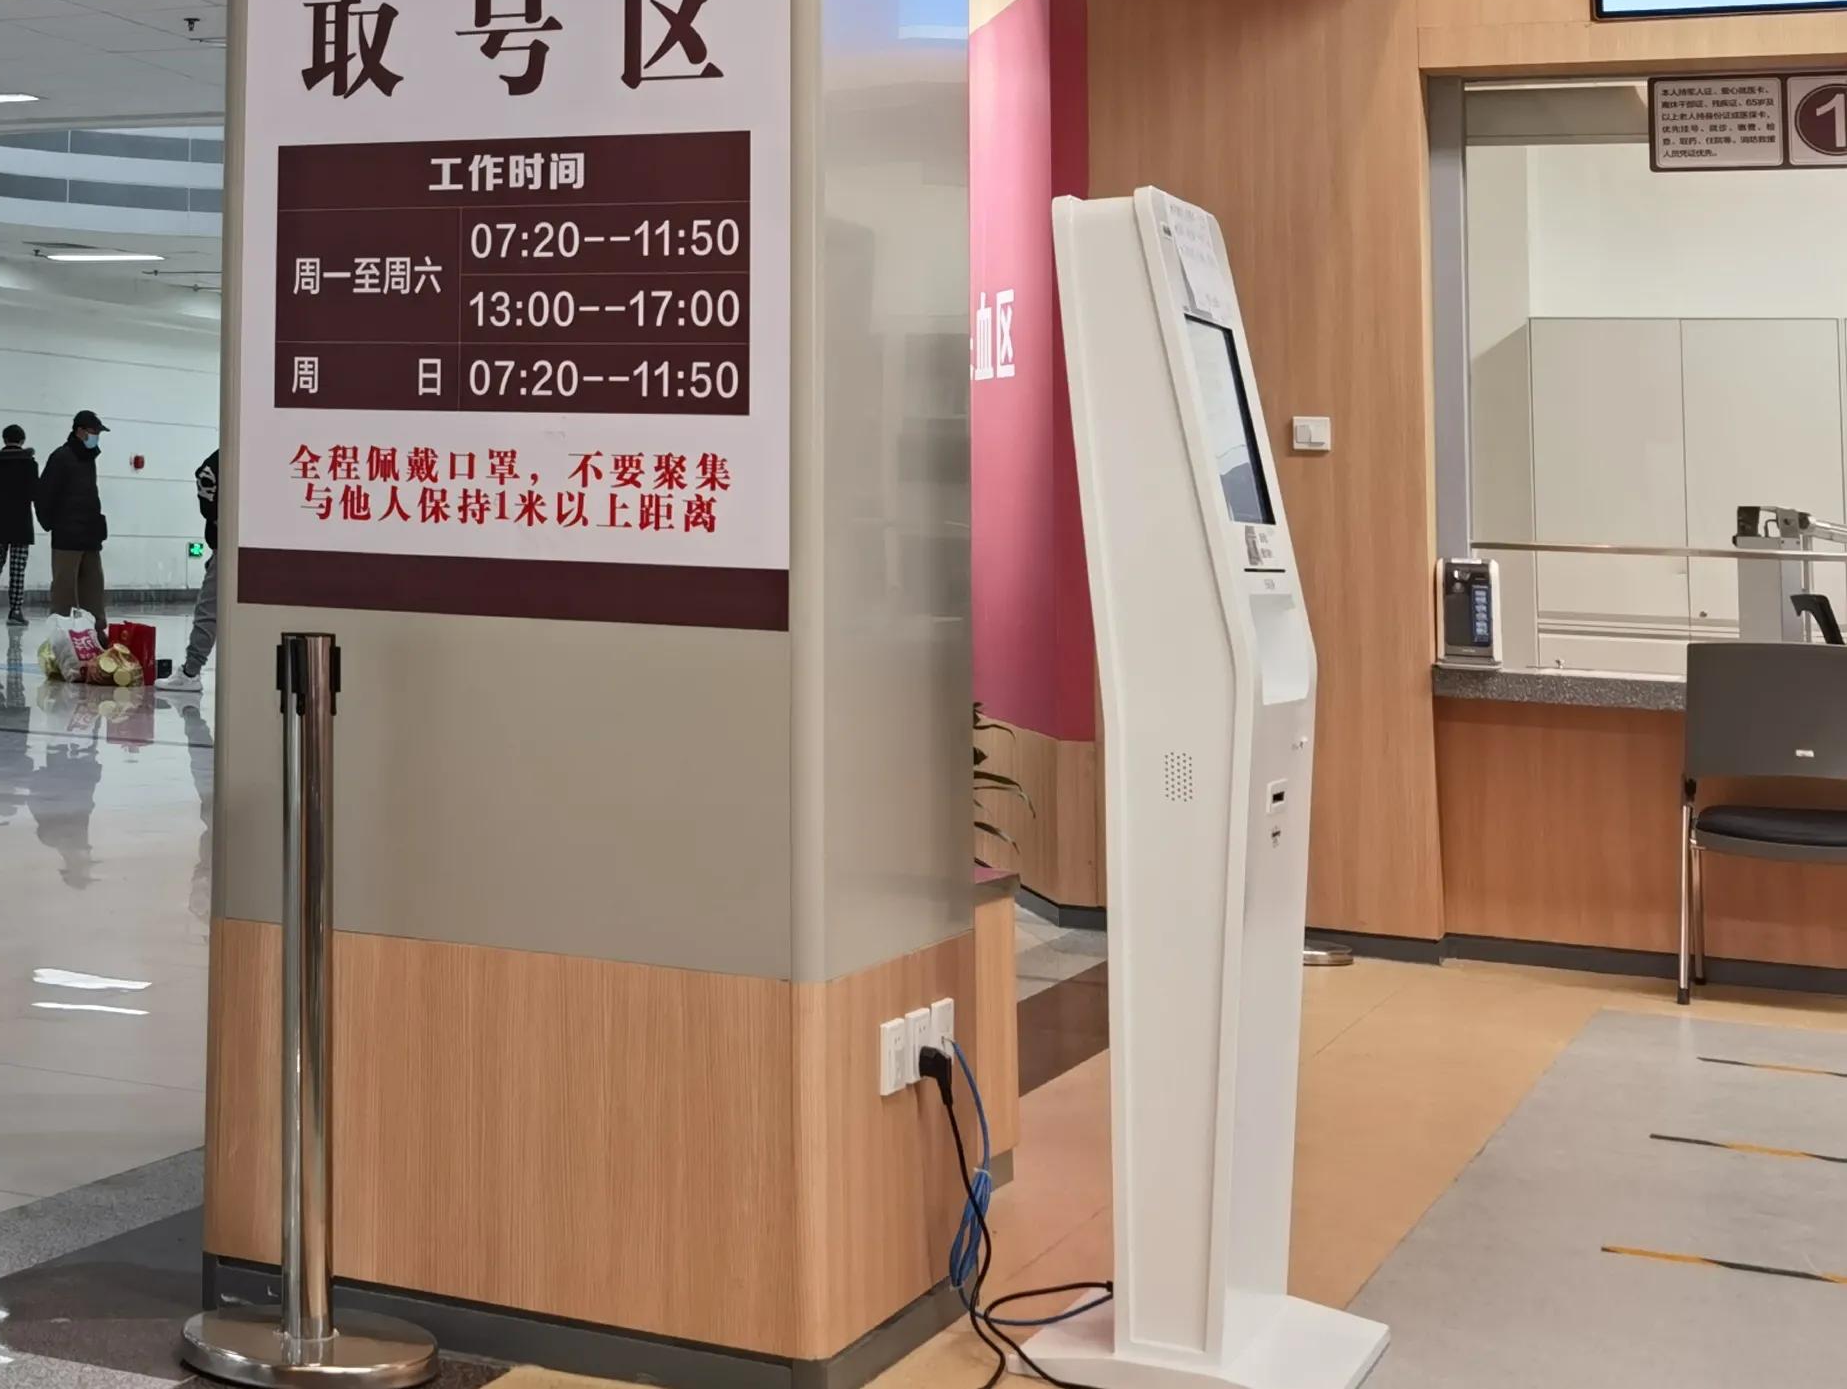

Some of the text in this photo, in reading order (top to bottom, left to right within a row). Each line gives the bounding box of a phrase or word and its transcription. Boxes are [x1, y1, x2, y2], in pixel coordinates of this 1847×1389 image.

[1816, 93, 1846, 148] 1
[428, 152, 585, 193] 工作时间
[293, 256, 442, 296] 周一至周六
[970, 289, 1015, 380] 血区
[300, 484, 719, 533] 与他人保持1米以上距离
